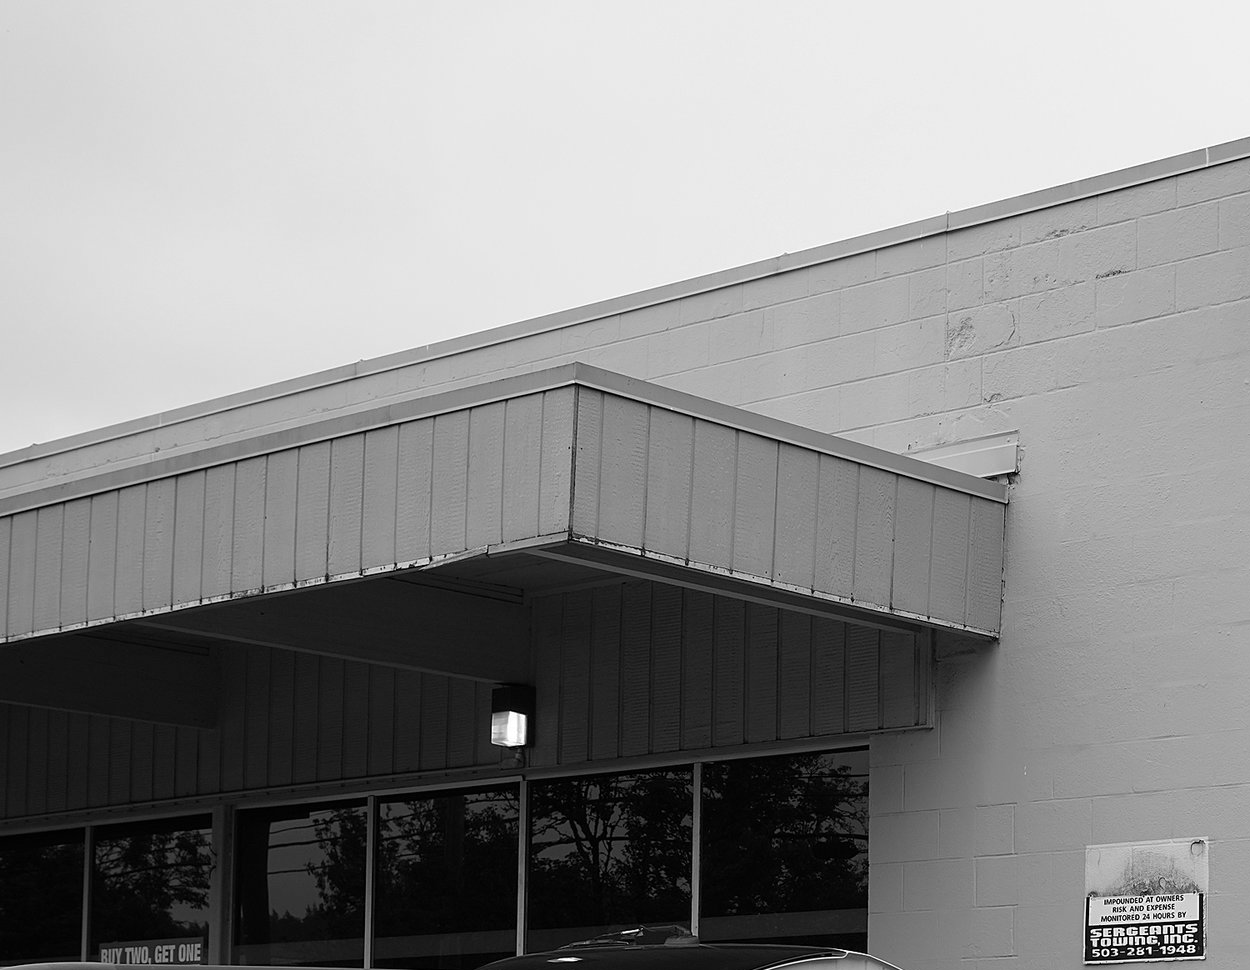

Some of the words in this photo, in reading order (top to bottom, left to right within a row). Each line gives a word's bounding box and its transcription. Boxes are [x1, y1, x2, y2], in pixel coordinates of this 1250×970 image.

[1104, 897, 1143, 905] IMPOUNDED
[1156, 895, 1184, 903] OWNERS
[1146, 903, 1175, 911] EXPENSE
[1100, 914, 1140, 922] MONITORED
[1090, 923, 1198, 938] SERGEANTS
[1163, 934, 1198, 945] INC.
[101, 949, 123, 965] BUY
[155, 945, 175, 963] GET
[178, 944, 201, 962] ONE
[1092, 945, 1196, 957] 503-281-1948
